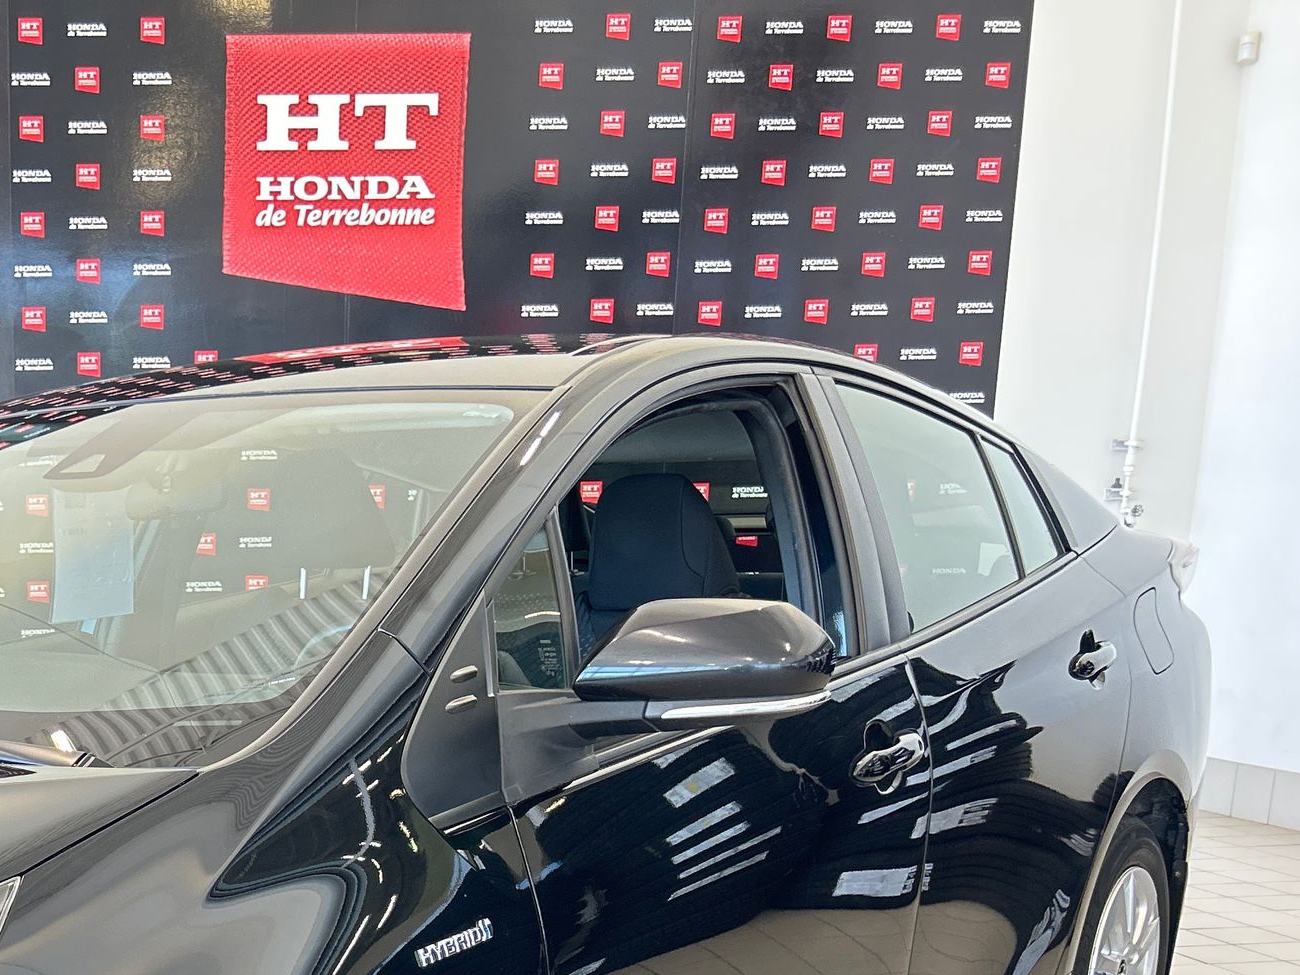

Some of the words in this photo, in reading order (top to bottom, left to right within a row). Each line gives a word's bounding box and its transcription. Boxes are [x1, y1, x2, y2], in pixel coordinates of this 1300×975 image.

[67, 23, 107, 31] HONDA
[766, 21, 803, 29] HONDA
[984, 20, 1021, 28] HONDA
[133, 72, 172, 80] HONDA
[596, 68, 634, 76] HONDA
[68, 121, 107, 129] HONDA
[256, 92, 439, 151] HT
[530, 117, 567, 125] HONDA
[591, 164, 628, 172] HONDA
[701, 166, 738, 174] HONDA
[809, 165, 846, 173] HONDA
[256, 175, 435, 201] HONDA
[255, 203, 286, 227] de
[293, 203, 435, 226] Terrebonne
[859, 211, 896, 219] HONDA
[695, 260, 731, 268] HONDA
[802, 258, 838, 266] HONDA
[521, 304, 558, 312] HONDA
[745, 305, 781, 313] HONDA
[16, 358, 53, 366] HONDA
[415, 918, 491, 968] HYBRID
